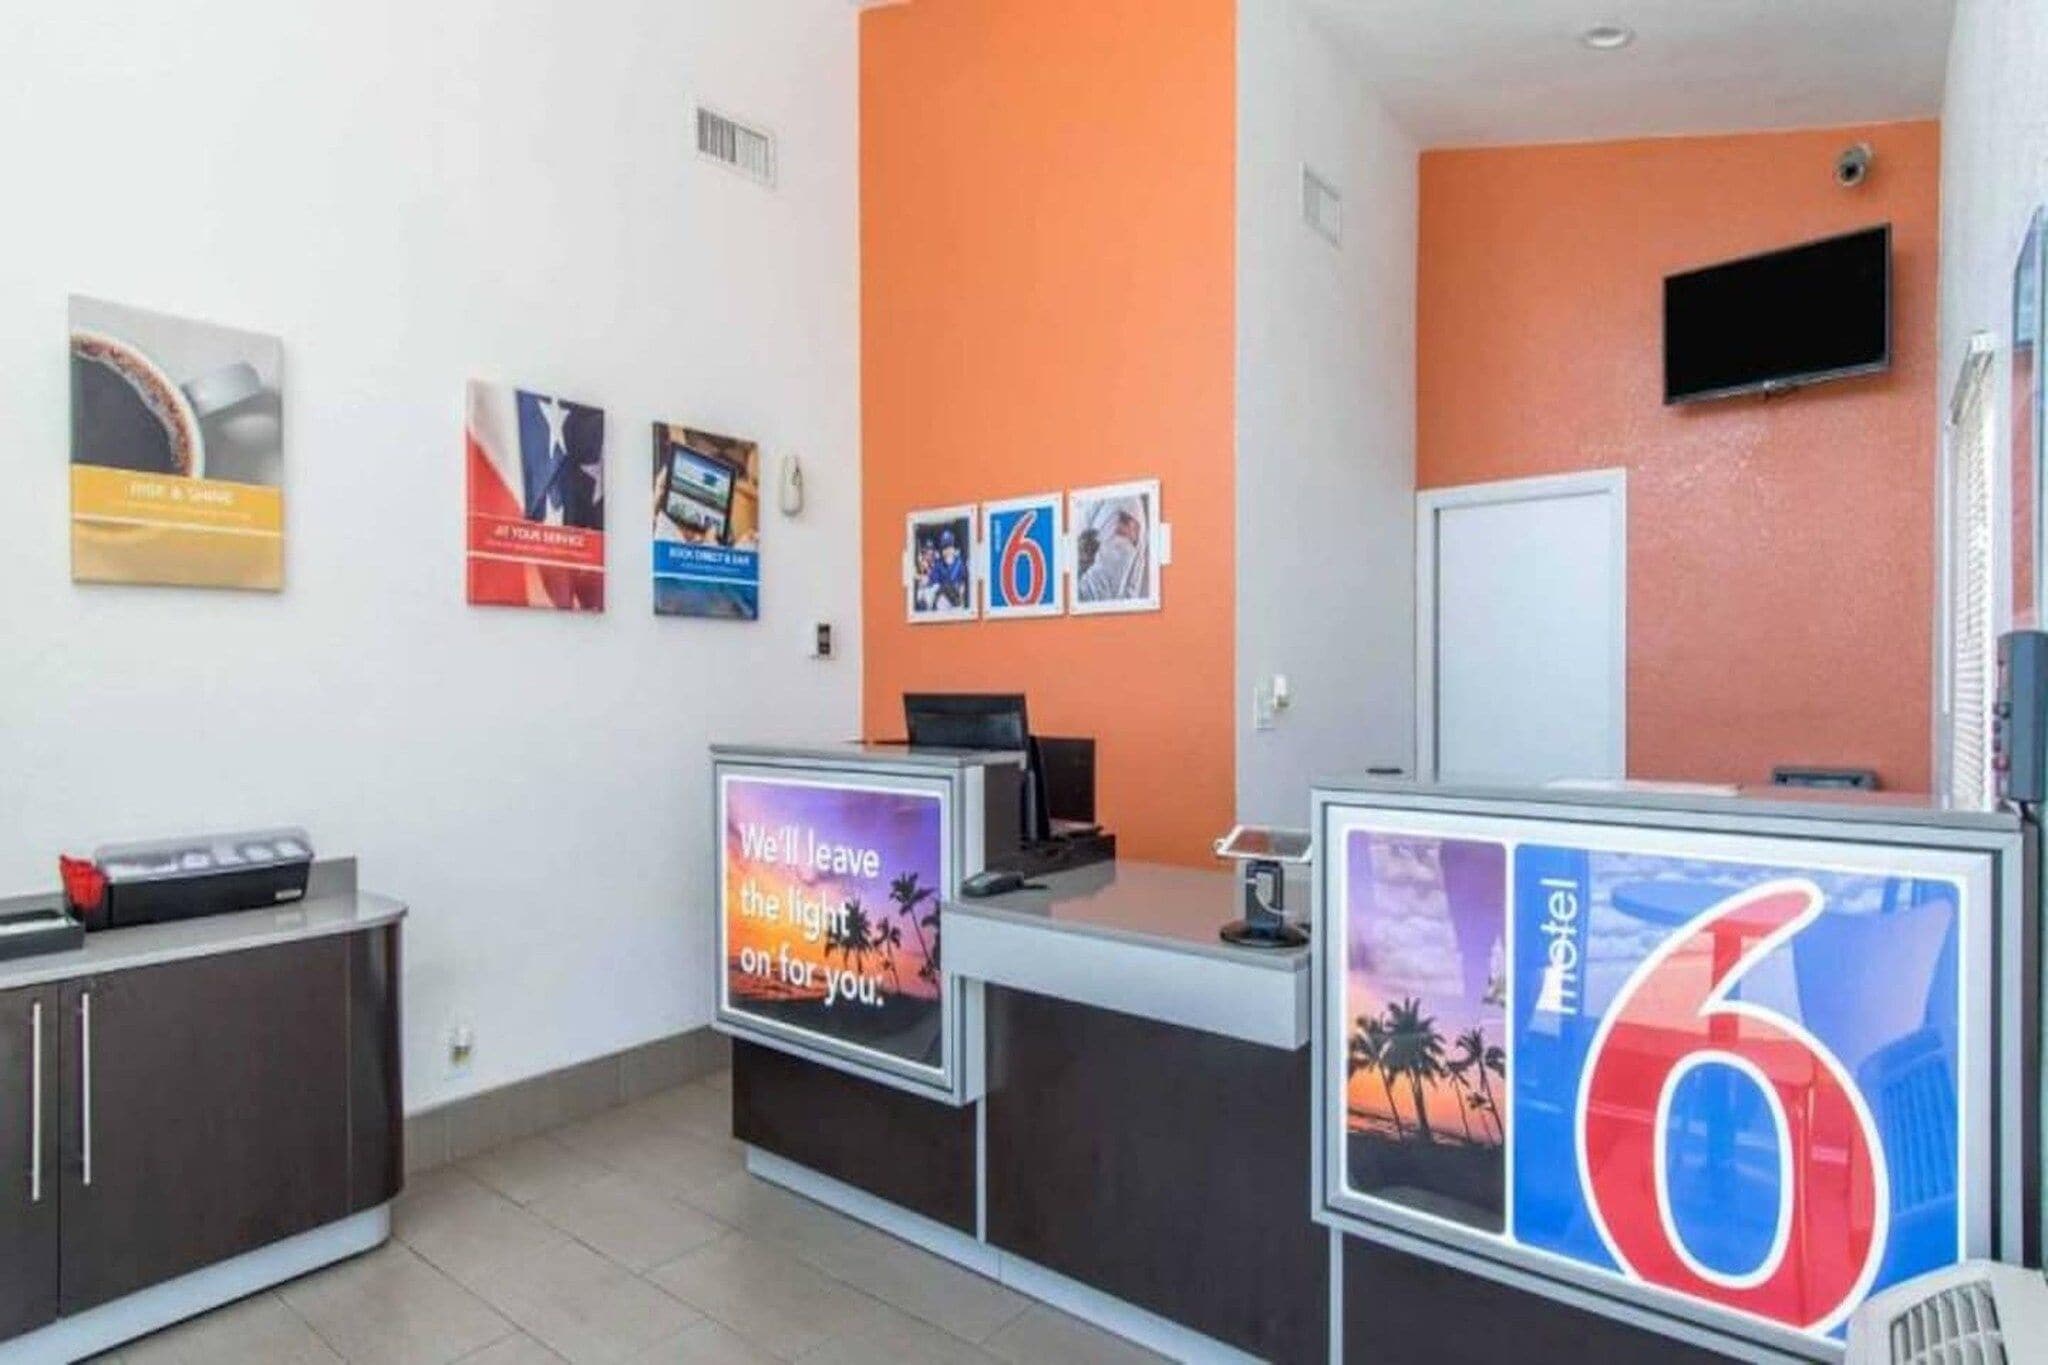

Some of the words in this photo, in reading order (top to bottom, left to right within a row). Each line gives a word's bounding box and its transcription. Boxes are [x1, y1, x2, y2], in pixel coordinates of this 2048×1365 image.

[999, 510, 1047, 607] 6
[739, 822, 799, 864] We'll
[807, 828, 881, 878] leave
[740, 879, 780, 921] the
[788, 886, 850, 941] light
[1538, 877, 1578, 1015] motel
[740, 946, 770, 979] on
[780, 941, 816, 987] for
[1575, 878, 1889, 1336] 6
